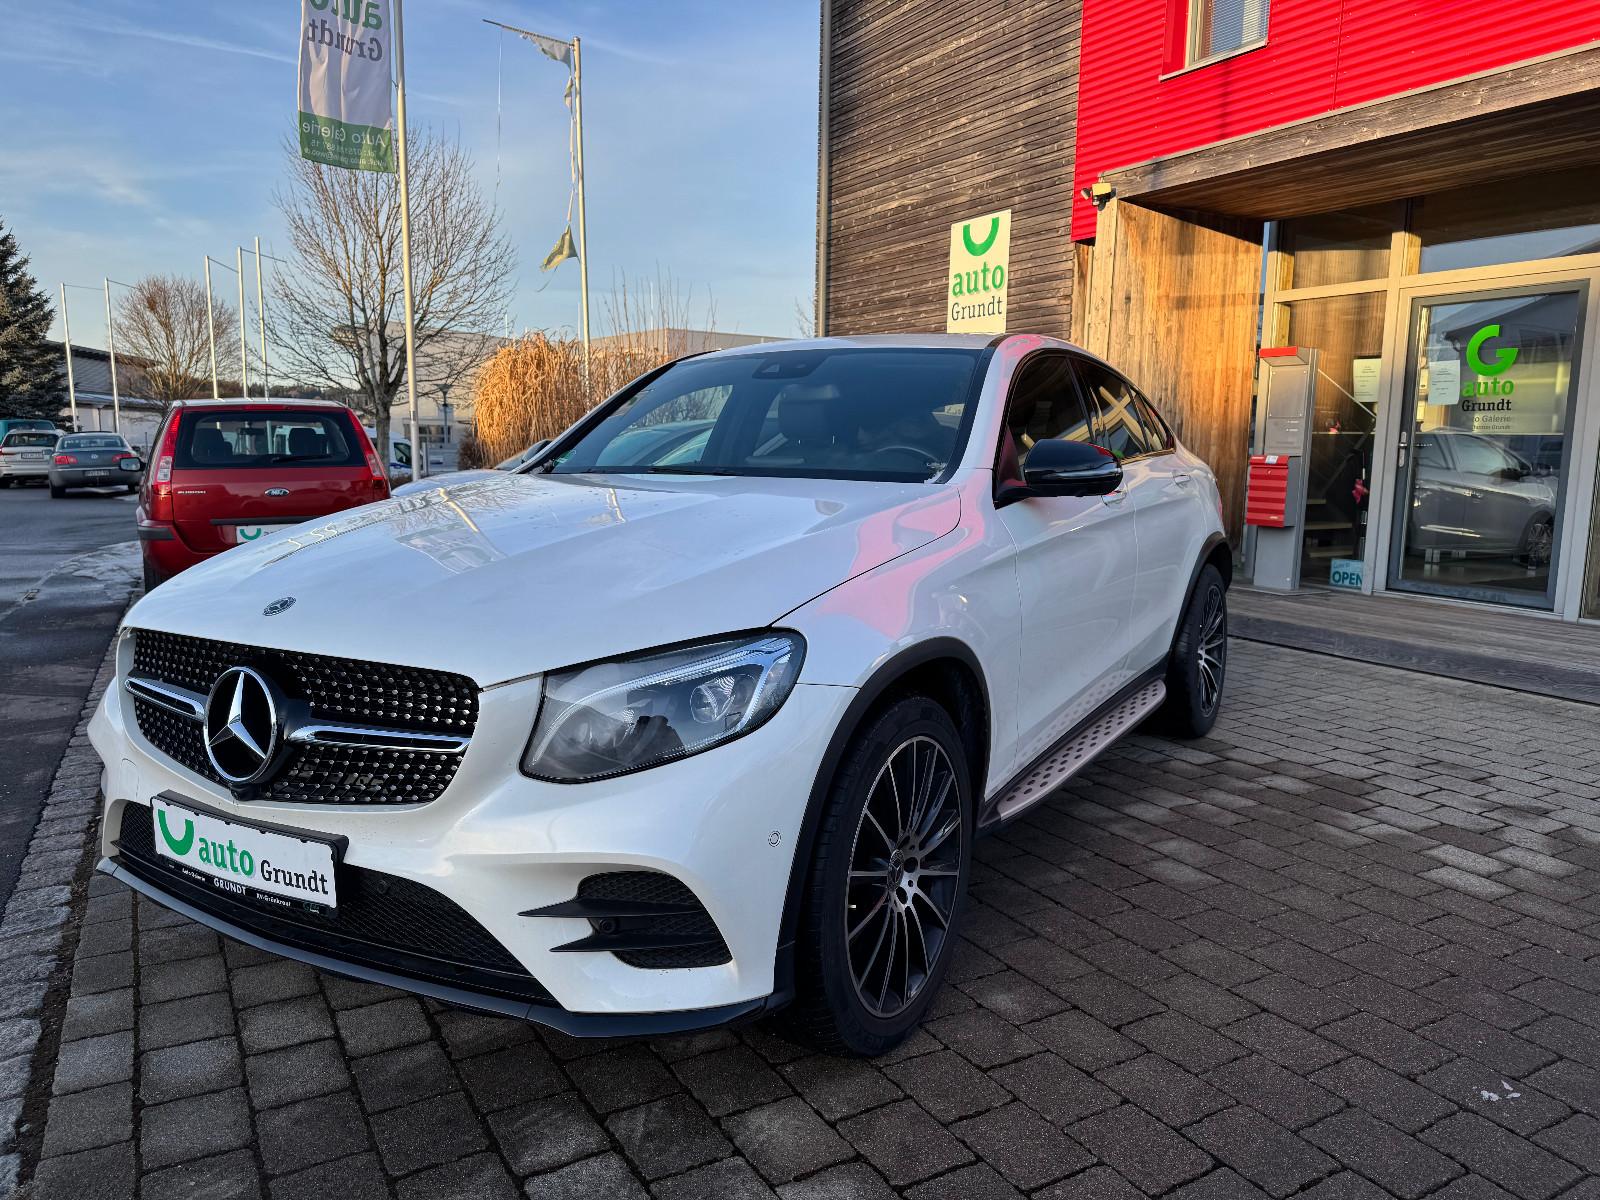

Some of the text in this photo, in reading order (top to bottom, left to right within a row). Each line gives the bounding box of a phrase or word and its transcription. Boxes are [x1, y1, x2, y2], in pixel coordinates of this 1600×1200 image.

[952, 261, 1005, 296] auto
[951, 296, 1003, 321] Grundt
[1462, 377, 1514, 397] auto
[1462, 398, 1512, 411] Grundt
[1332, 571, 1362, 586] OPEN
[198, 837, 329, 895] auto Grundt
[213, 877, 246, 895] GRUNDT
